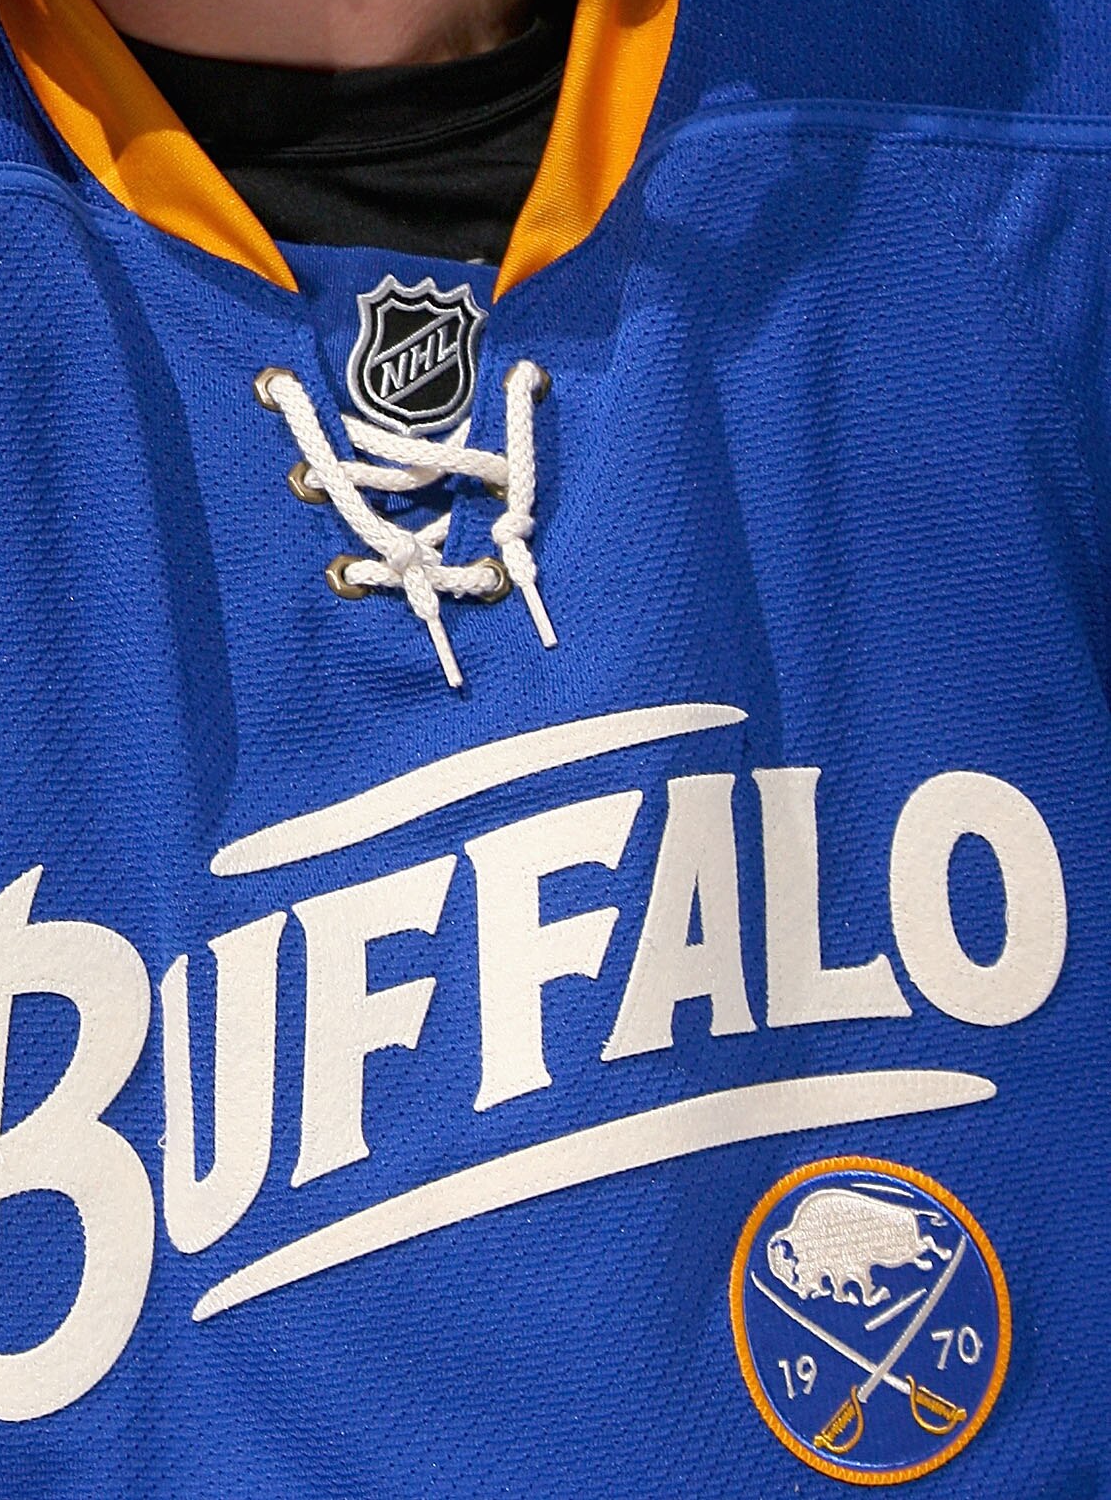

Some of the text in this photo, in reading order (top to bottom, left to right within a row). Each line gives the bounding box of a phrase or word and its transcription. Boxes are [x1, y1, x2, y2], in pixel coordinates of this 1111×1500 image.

[381, 325, 458, 398] NHL
[778, 1326, 983, 1399] 19 70
